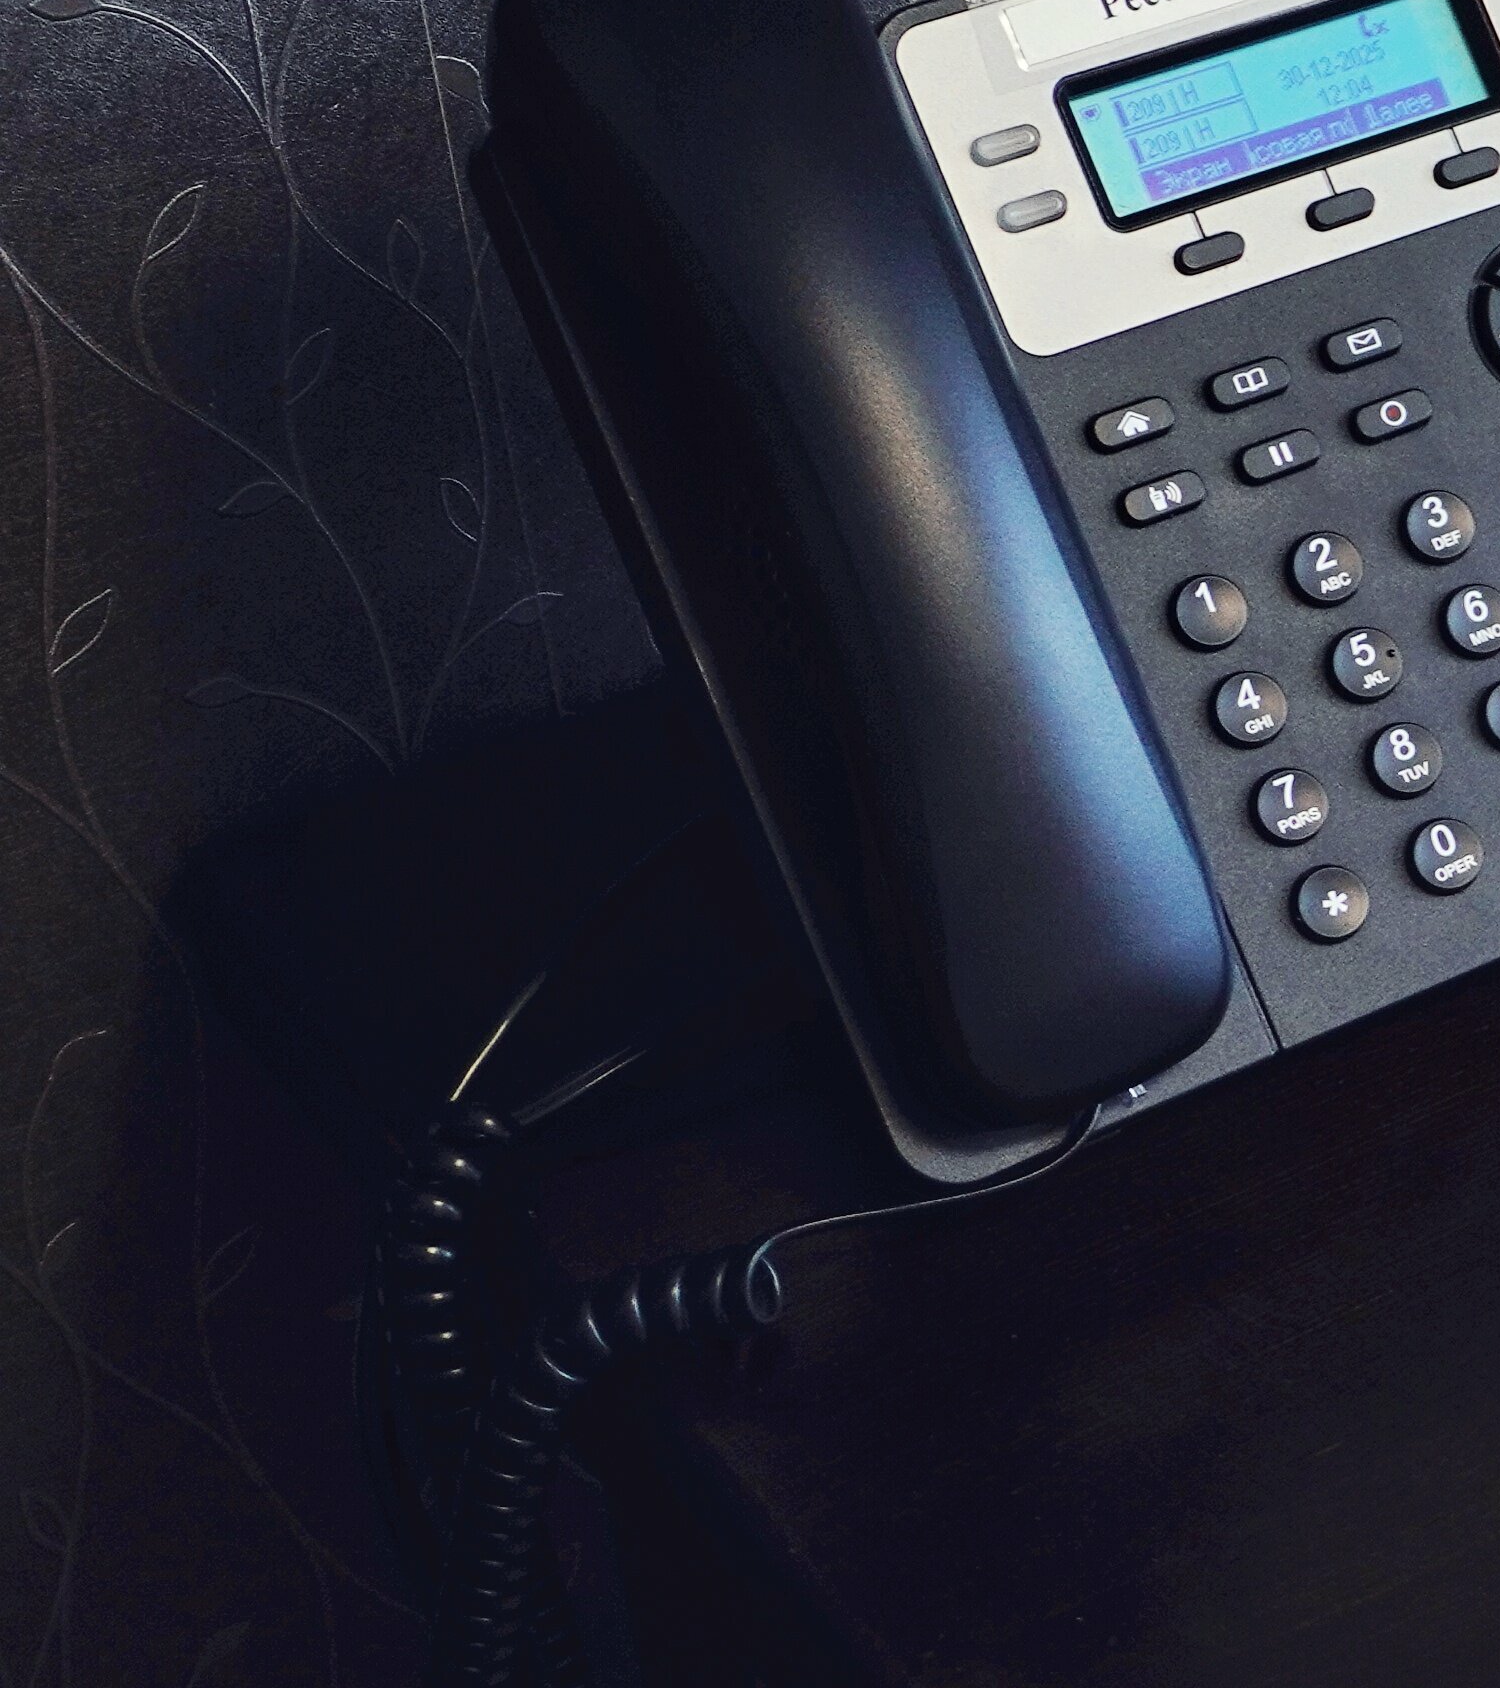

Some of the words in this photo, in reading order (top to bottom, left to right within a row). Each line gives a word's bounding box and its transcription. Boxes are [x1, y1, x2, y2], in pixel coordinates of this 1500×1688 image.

[1317, 74, 1374, 107] 12:04
[1127, 92, 1167, 123] 209
[1142, 129, 1182, 159] 209
[1154, 158, 1233, 195] Экран
[1422, 496, 1448, 528] 3
[1308, 538, 1338, 572] 2
[1431, 529, 1463, 552] DEF
[1194, 581, 1218, 613] 1
[1319, 572, 1352, 595] ABC
[1463, 589, 1489, 622] 6
[1349, 633, 1376, 667] 5
[1237, 678, 1262, 710] 4
[1362, 669, 1390, 691] JKL
[1245, 713, 1274, 735] GHI
[1390, 728, 1416, 761] 8
[1398, 761, 1429, 783] TUV
[1272, 774, 1296, 809] 7
[1277, 806, 1322, 834] PQRS
[1430, 824, 1456, 857] 0
[1434, 854, 1478, 882] OPER
